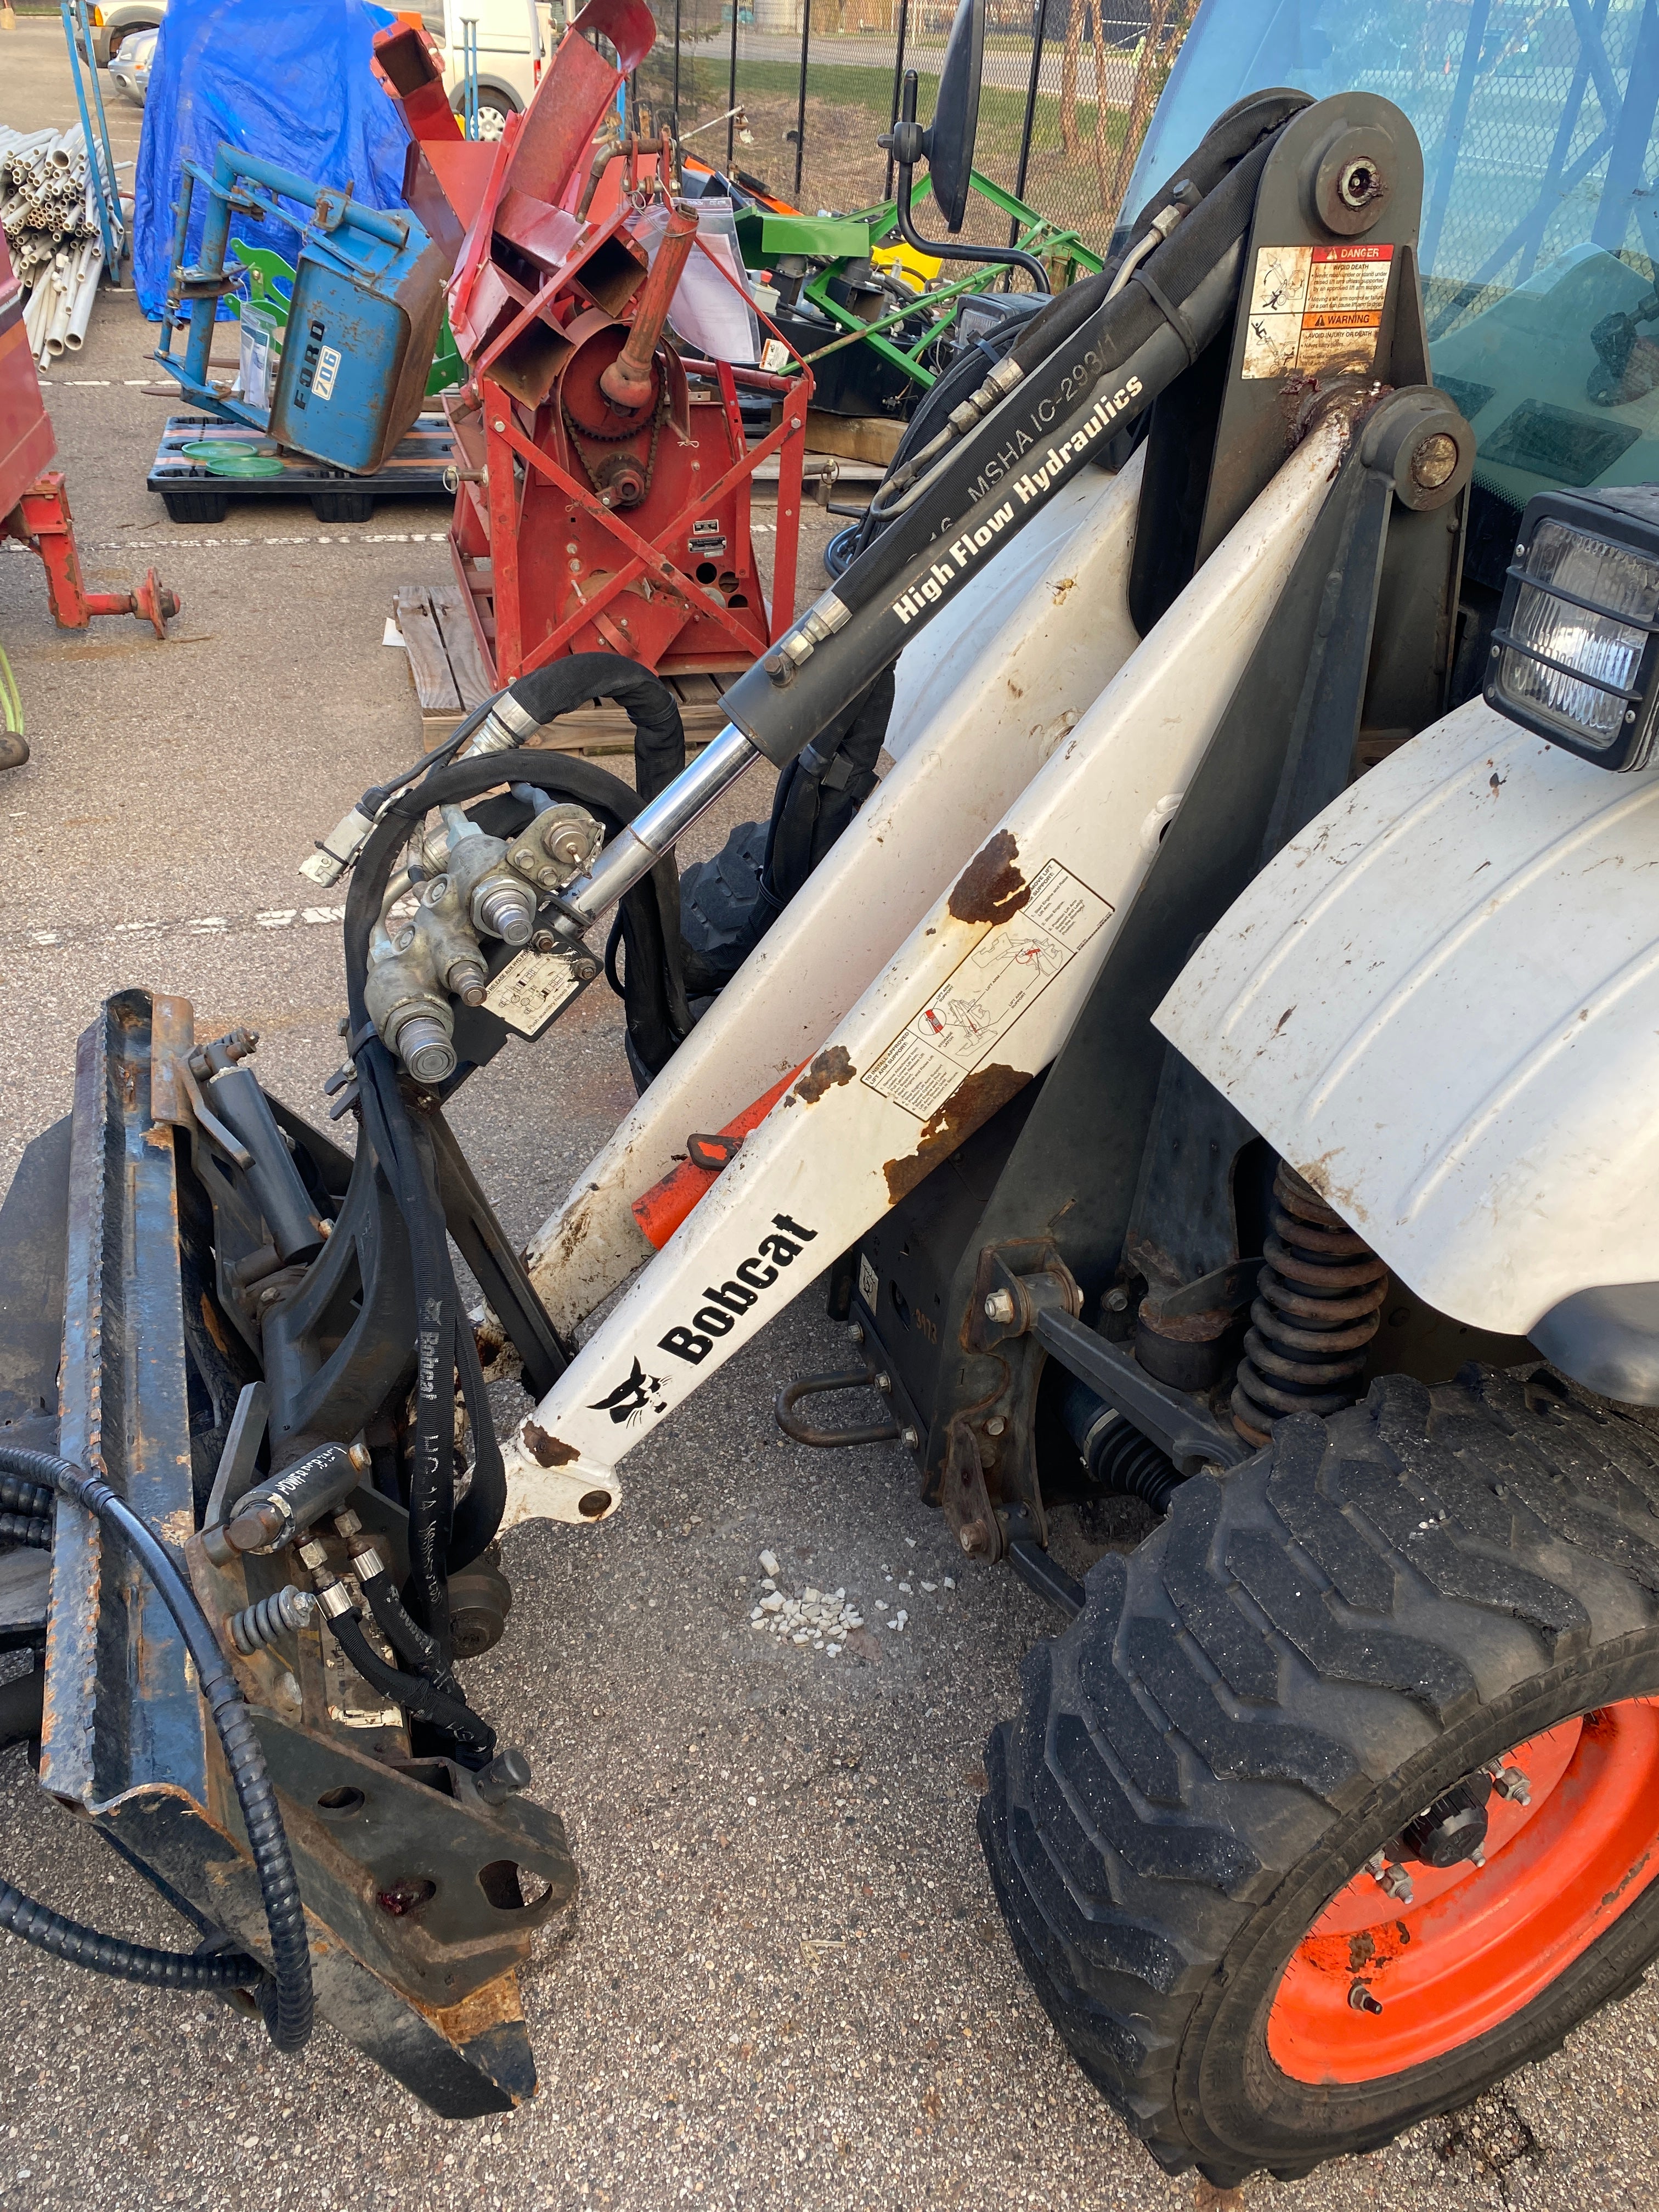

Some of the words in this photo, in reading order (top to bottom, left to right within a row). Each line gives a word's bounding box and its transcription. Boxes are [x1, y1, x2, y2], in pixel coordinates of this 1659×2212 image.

[1341, 248, 1380, 257] DANGER
[1327, 315, 1370, 324] WARNING
[294, 319, 325, 410] FORD
[315, 351, 336, 396] 706
[967, 428, 1034, 503] MSHA
[891, 561, 955, 624] High
[949, 500, 1014, 568] Flow
[1013, 375, 1144, 504] Hydraulics
[1042, 864, 1053, 876] LIFT
[1034, 904, 1043, 915] Start
[1041, 891, 1054, 906] Engine
[489, 973, 506, 992] RELEASE
[504, 964, 514, 975] AUX
[512, 956, 522, 967] HYD
[939, 985, 954, 1002] SUPPORT
[1011, 992, 1026, 1008] SUPPORT
[527, 1018, 539, 1030] Push
[538, 1000, 556, 1020] auxiliary
[554, 987, 567, 1002] hoses
[938, 1031, 953, 1048] STORAGE
[943, 1036, 954, 1047] LATCH
[870, 1056, 888, 1075] INSTALL
[886, 1031, 910, 1057] APPROVED
[869, 1074, 879, 1085] LIFT
[877, 1063, 889, 1075] ARM
[883, 1073, 895, 1086] Remove
[894, 1054, 912, 1074] Attachment
[896, 1066, 907, 1077] Lower
[904, 1076, 916, 1088] Engine
[657, 1213, 819, 1365] Bobcat
[419, 1331, 438, 1400] Bobcat
